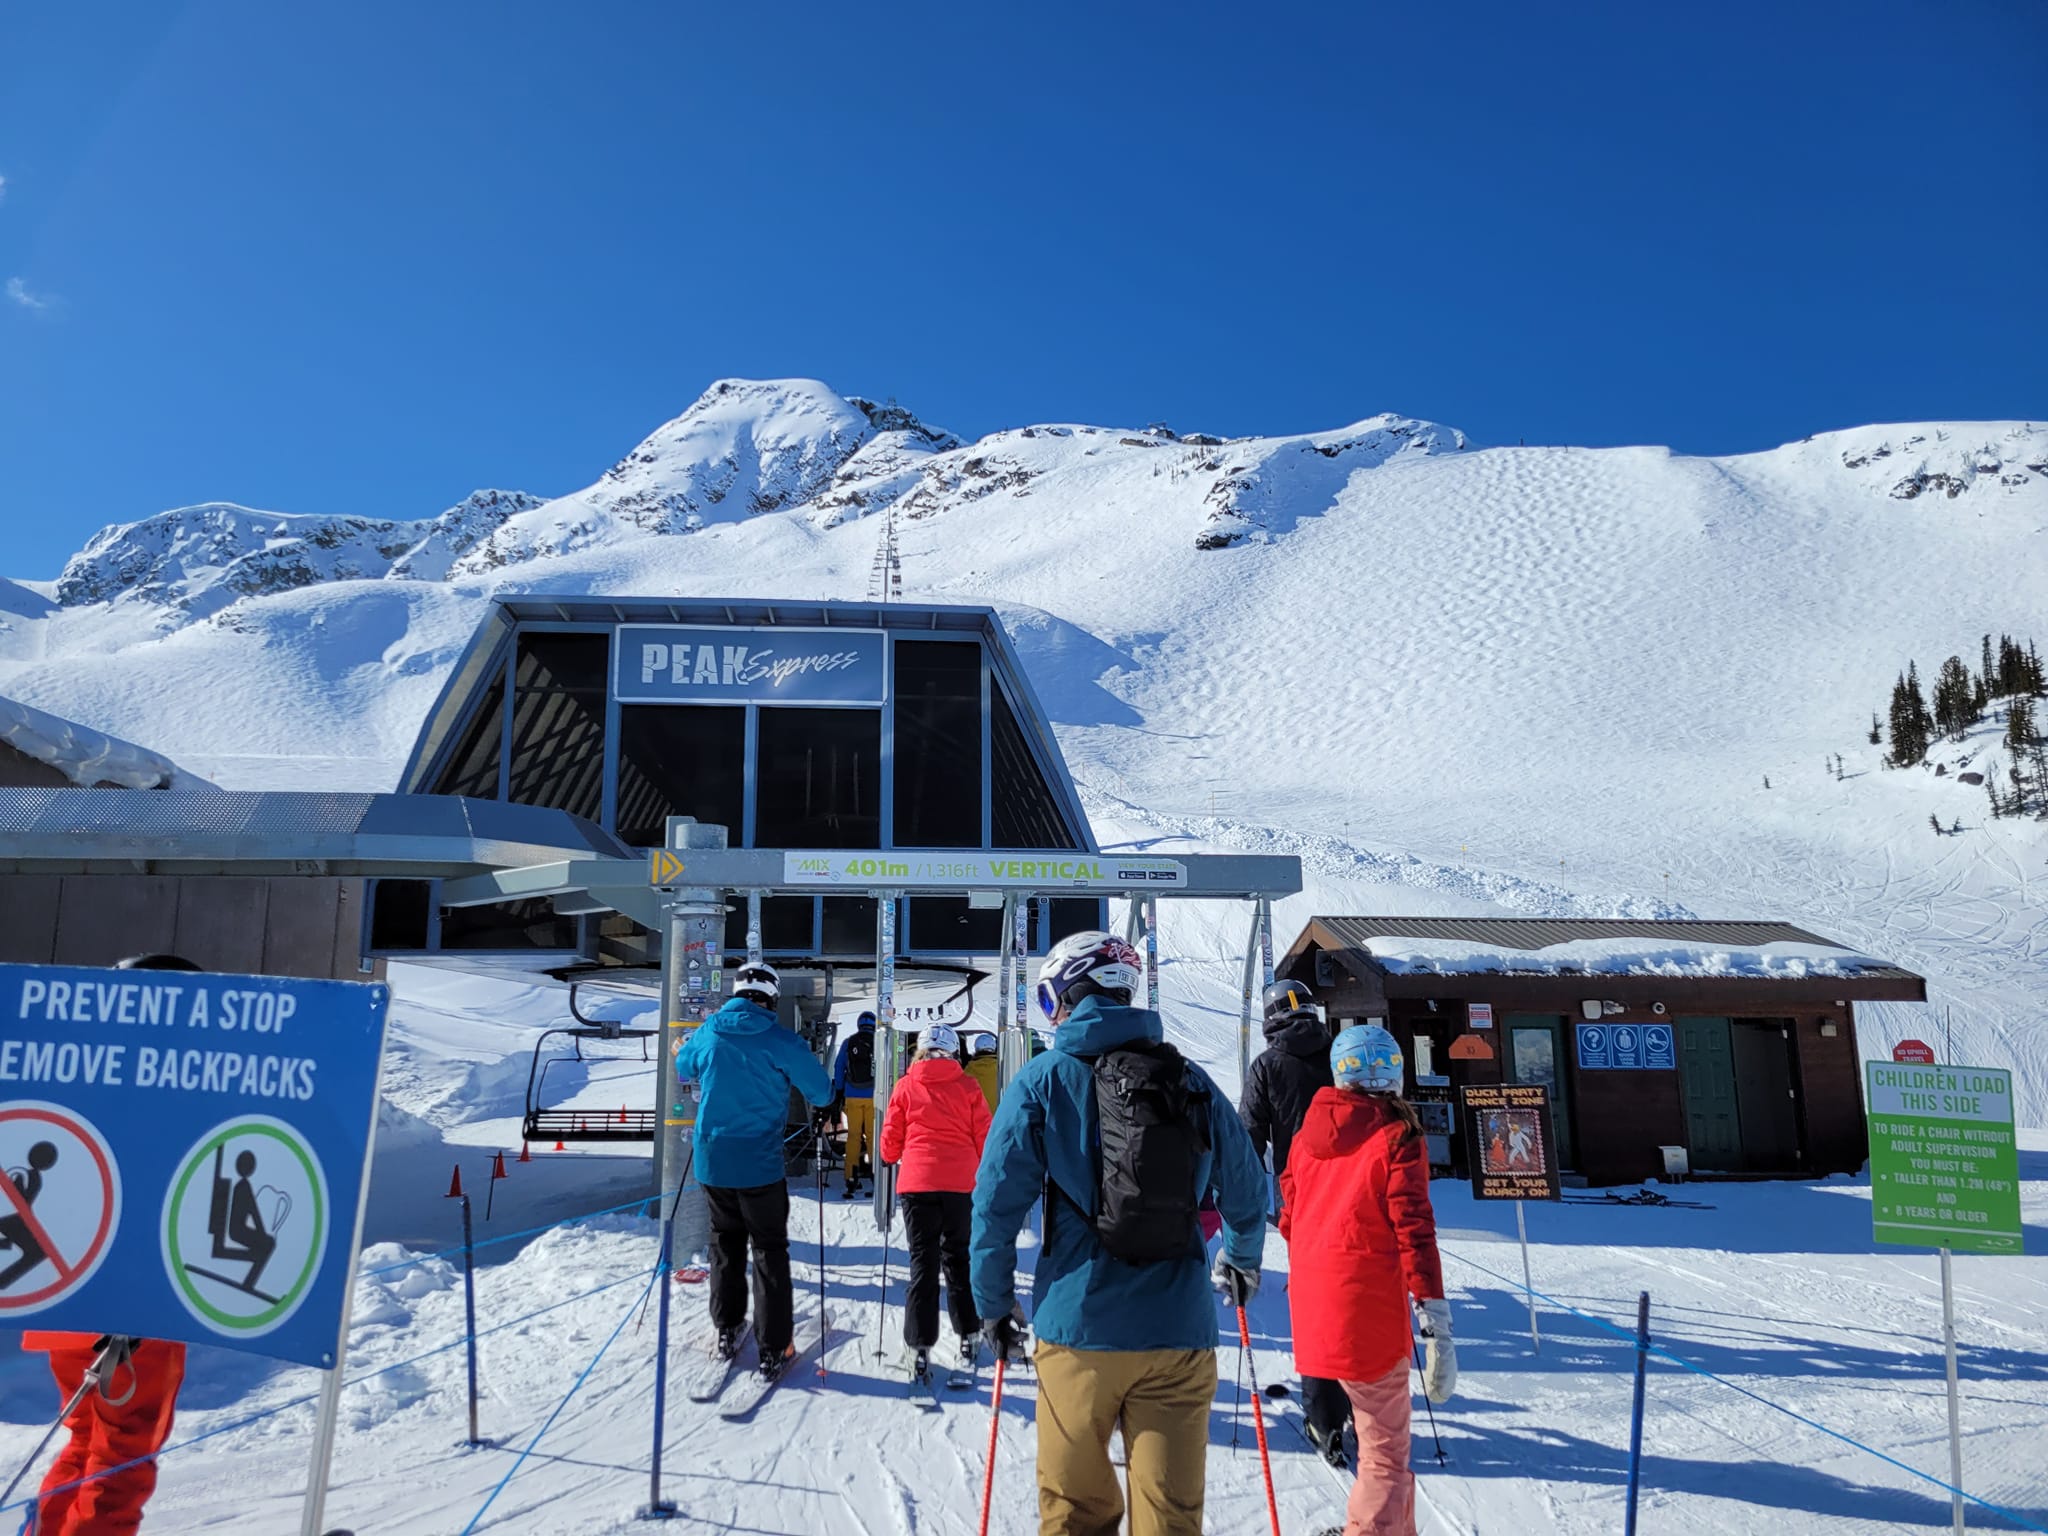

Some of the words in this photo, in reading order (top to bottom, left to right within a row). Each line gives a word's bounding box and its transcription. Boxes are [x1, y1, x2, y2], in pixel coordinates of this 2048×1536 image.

[641, 644, 749, 686] PEAK
[743, 649, 861, 688] Express
[845, 859, 909, 877] 401m
[927, 863, 979, 879] 1,316ft
[989, 860, 1105, 879] VERTICAL
[19, 979, 183, 1026] PREVENT
[188, 988, 209, 1029] A
[218, 990, 297, 1034] STOP
[136, 1047, 317, 1101] BACKPACKS
[1875, 1069, 1957, 1091] CHILDREN
[1963, 1076, 2005, 1094] LOAD
[1465, 1088, 1498, 1097] DUCK
[1466, 1097, 1507, 1106] DANCE
[1511, 1096, 1545, 1106] ZONE
[1901, 1092, 1937, 1111] THIS
[1944, 1095, 1982, 1114] SIDE
[1874, 1122, 1888, 1134] TO
[1890, 1124, 1915, 1137] RIDE
[1918, 1126, 1926, 1138] A
[1928, 1126, 1960, 1140] CHAIR
[1963, 1129, 2011, 1144] WITHOUT
[1891, 1140, 1923, 1153] ADULT
[1926, 1142, 1997, 1159] SUPERVISION
[1910, 1158, 1931, 1169] YOU
[1933, 1160, 1960, 1172] MUST
[1483, 1179, 1508, 1188] GET
[1513, 1179, 1548, 1188] YOUR
[1894, 1172, 1929, 1185] TALLER
[1931, 1175, 1956, 1188] THAN
[1483, 1187, 1525, 1197] QUACK
[1936, 1193, 1957, 1205] AND
[1904, 1206, 1936, 1219] YEARS
[1939, 1210, 1953, 1221] OR
[1955, 1211, 1988, 1223] OLDER
